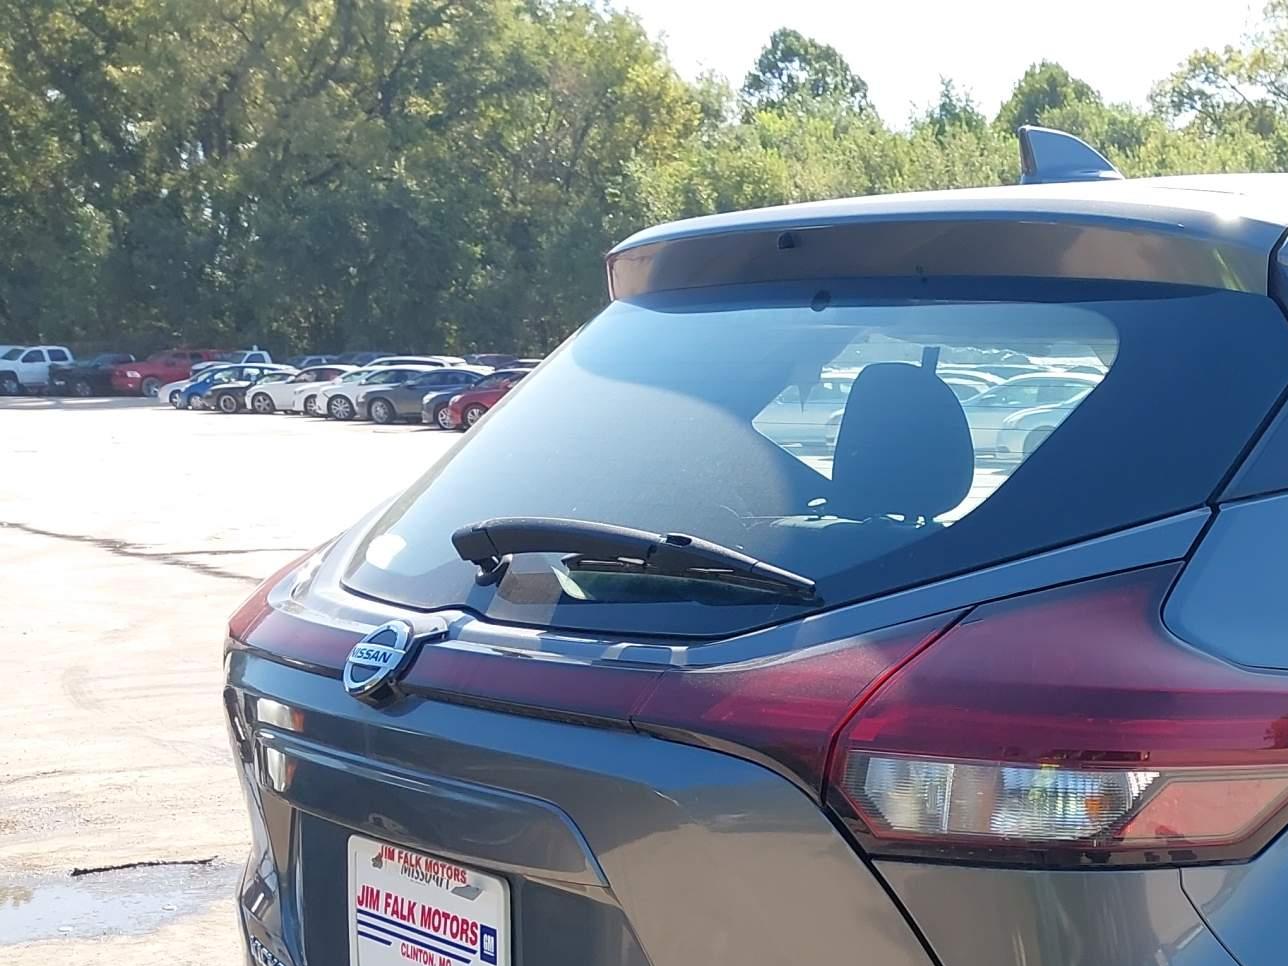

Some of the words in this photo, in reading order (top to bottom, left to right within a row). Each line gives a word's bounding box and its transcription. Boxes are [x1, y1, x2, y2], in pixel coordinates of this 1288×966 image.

[351, 647, 393, 664] NISSAN
[379, 846, 395, 862] JIM
[397, 851, 422, 868] FALK
[424, 858, 467, 884] MOTORS
[357, 885, 380, 912] JIM
[384, 892, 416, 925] FALK
[420, 904, 478, 946] MOTORS
